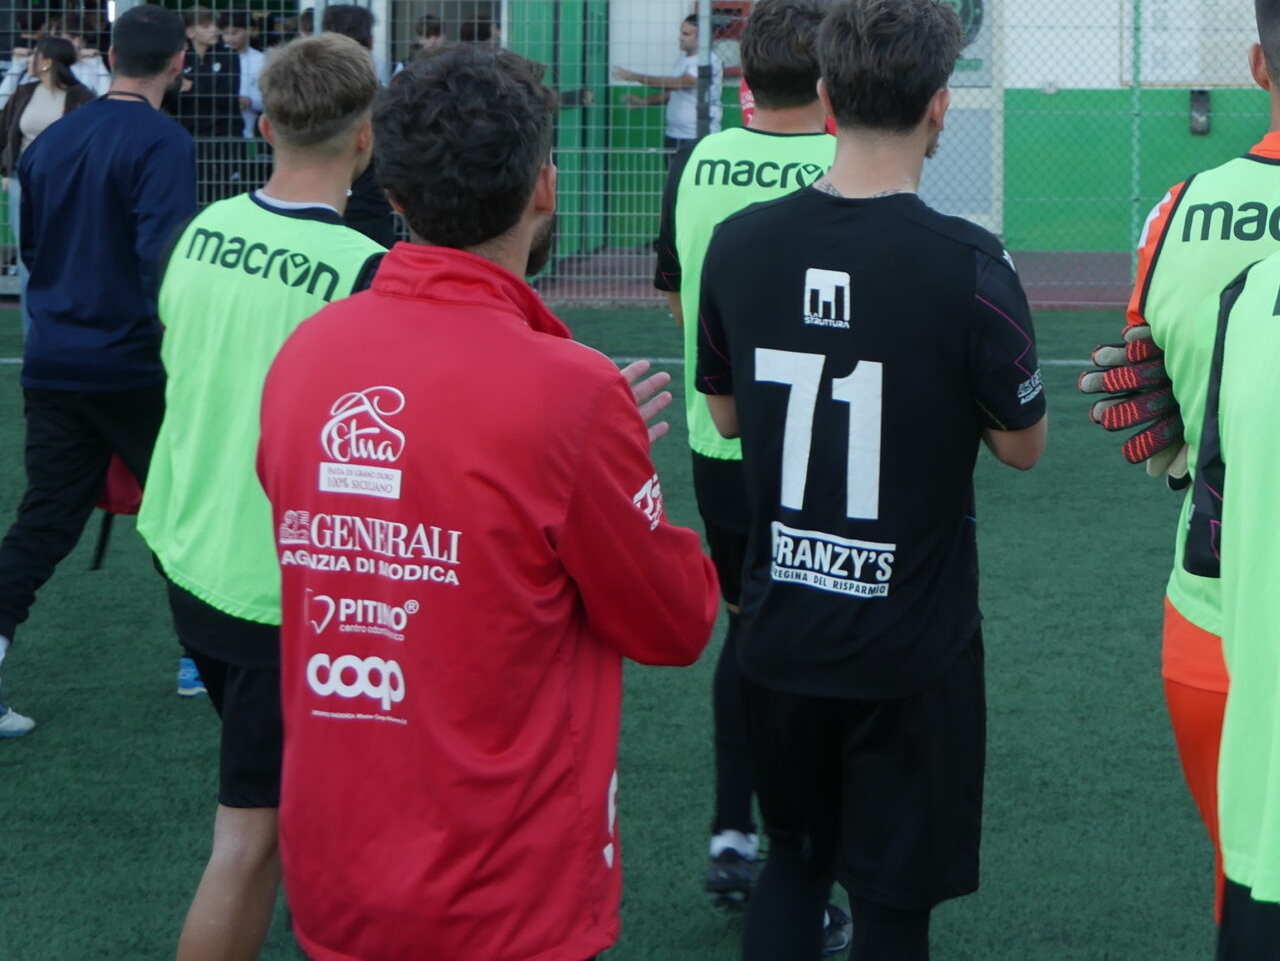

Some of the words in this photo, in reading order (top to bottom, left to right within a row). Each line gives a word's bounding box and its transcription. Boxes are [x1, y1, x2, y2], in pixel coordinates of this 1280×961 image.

[694, 159, 830, 189] macro
[185, 227, 340, 303] macron
[754, 347, 883, 520] 71
[281, 549, 352, 572] AGNZIA
[355, 556, 376, 575] DI
[310, 512, 463, 565] GENERALI
[813, 574, 828, 588] DEL
[832, 579, 887, 596] RISPARMIO
[306, 652, 406, 712] coop
